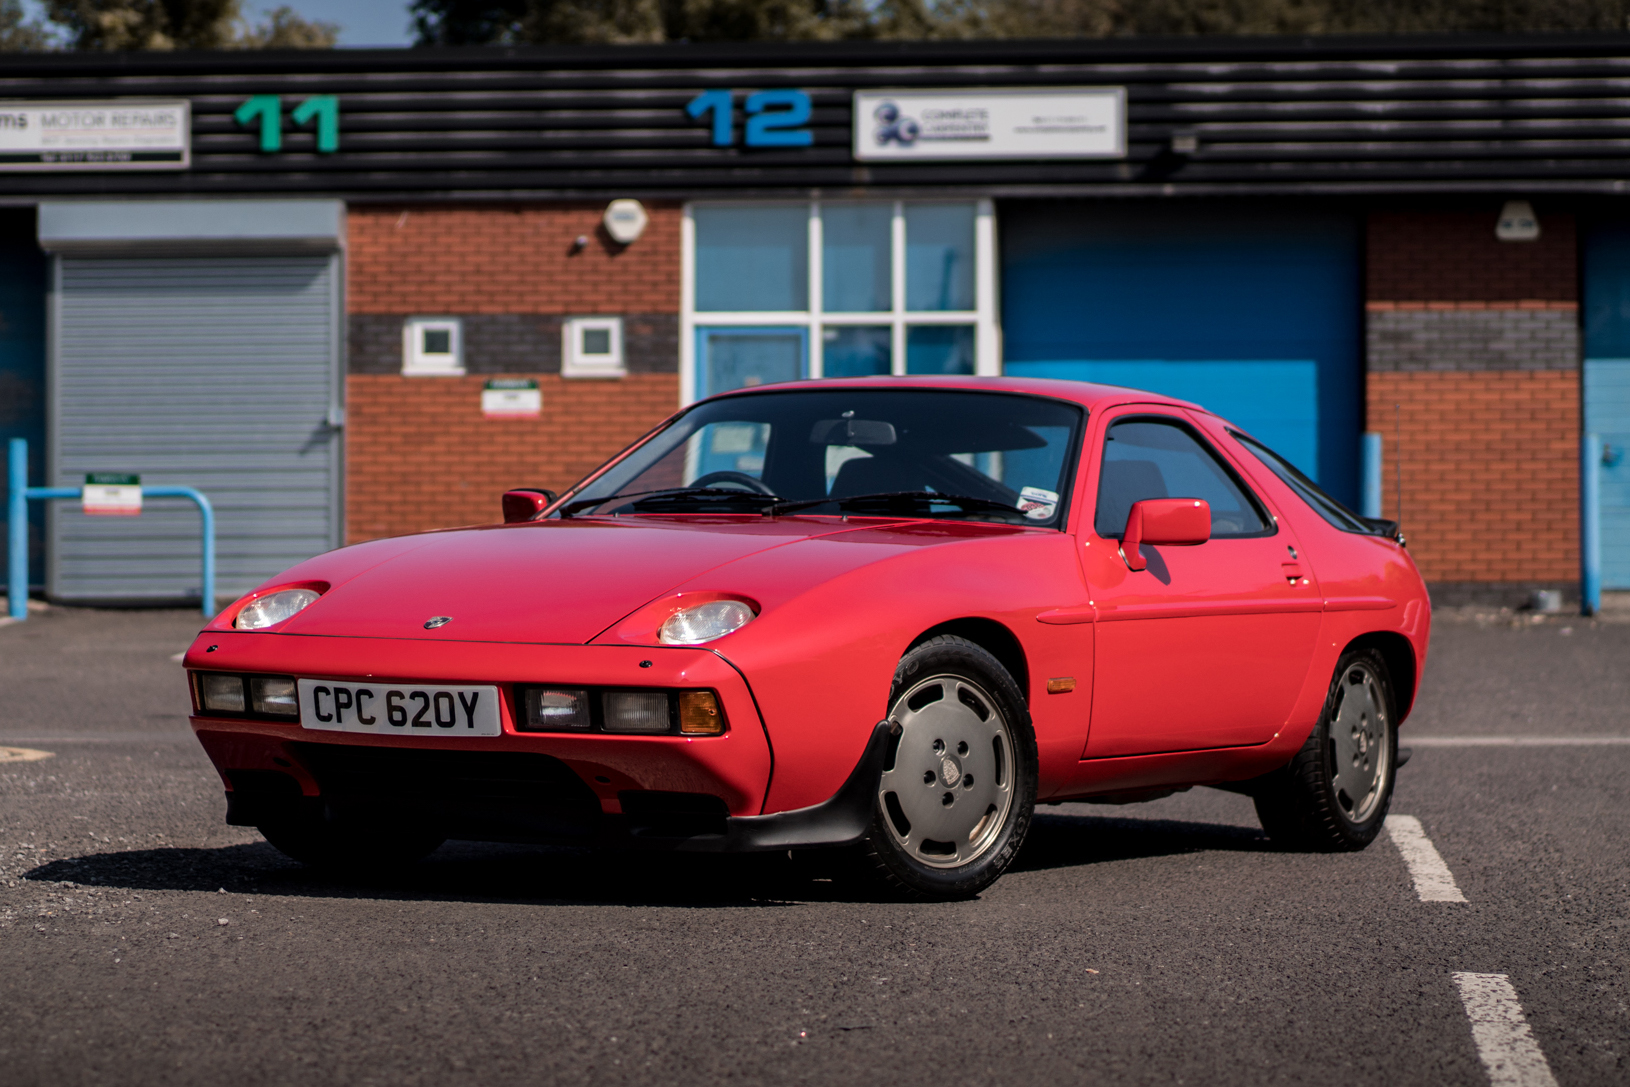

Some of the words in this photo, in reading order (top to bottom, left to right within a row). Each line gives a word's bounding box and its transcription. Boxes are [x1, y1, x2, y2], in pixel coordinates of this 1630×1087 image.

[41, 111, 106, 127] MOTOR
[112, 110, 177, 127] REPAIRS
[235, 95, 339, 151] 11
[687, 90, 813, 146] 12
[314, 686, 376, 725] CPC
[386, 690, 480, 729] 620Y
